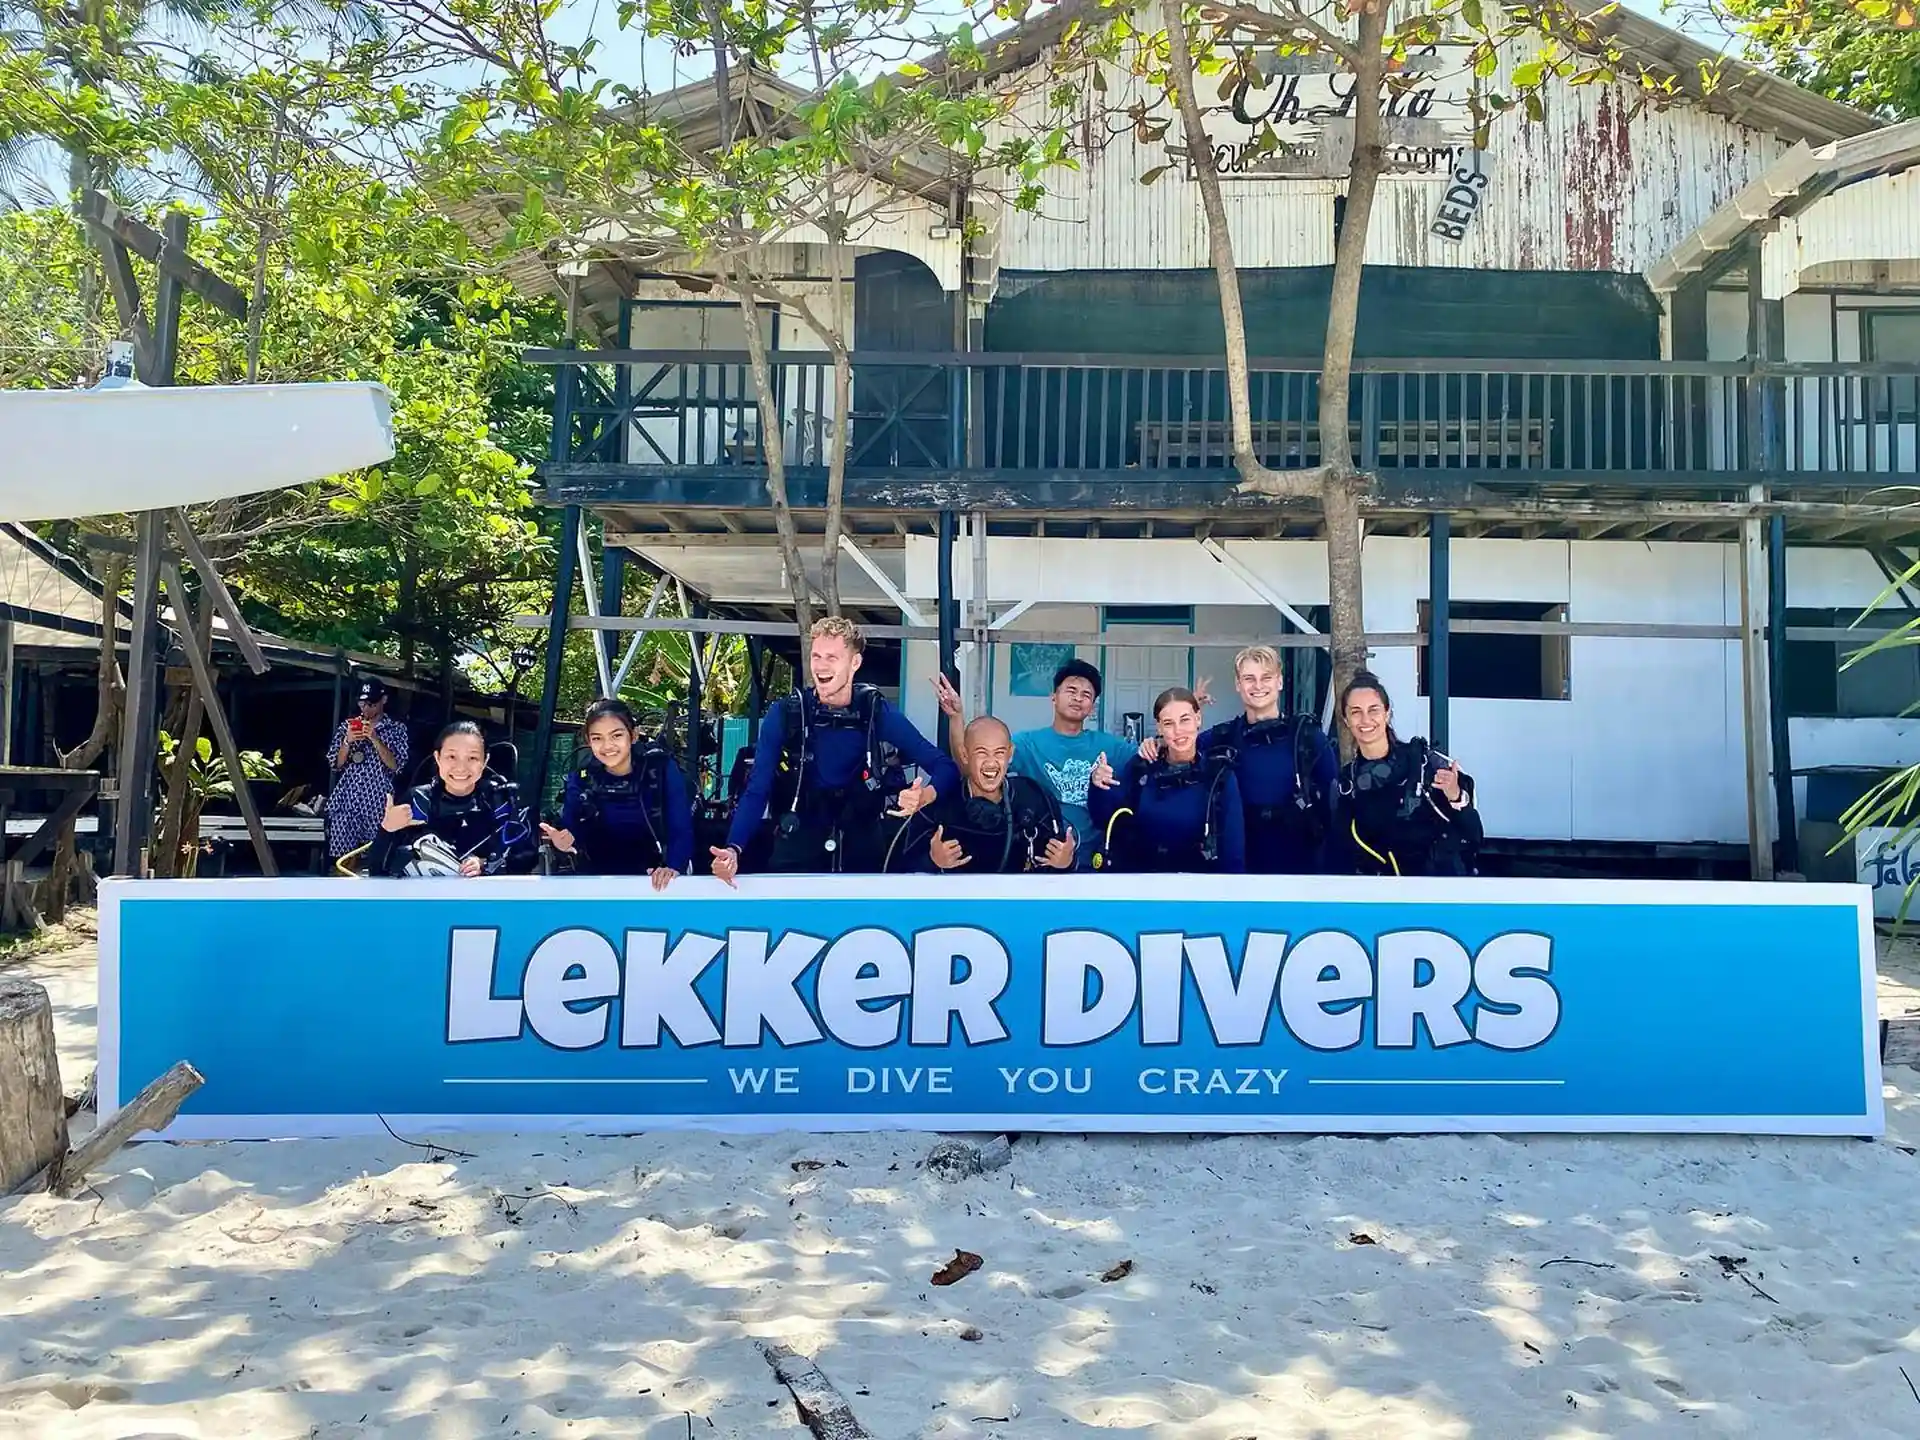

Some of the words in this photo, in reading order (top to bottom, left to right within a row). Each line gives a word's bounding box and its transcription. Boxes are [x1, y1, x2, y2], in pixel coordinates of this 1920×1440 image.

[1431, 167, 1489, 241] BEDS
[729, 1067, 799, 1093] WE
[848, 1067, 952, 1093] DIVE
[999, 1067, 1091, 1093] YOU
[1139, 1068, 1288, 1094] CRAZY
